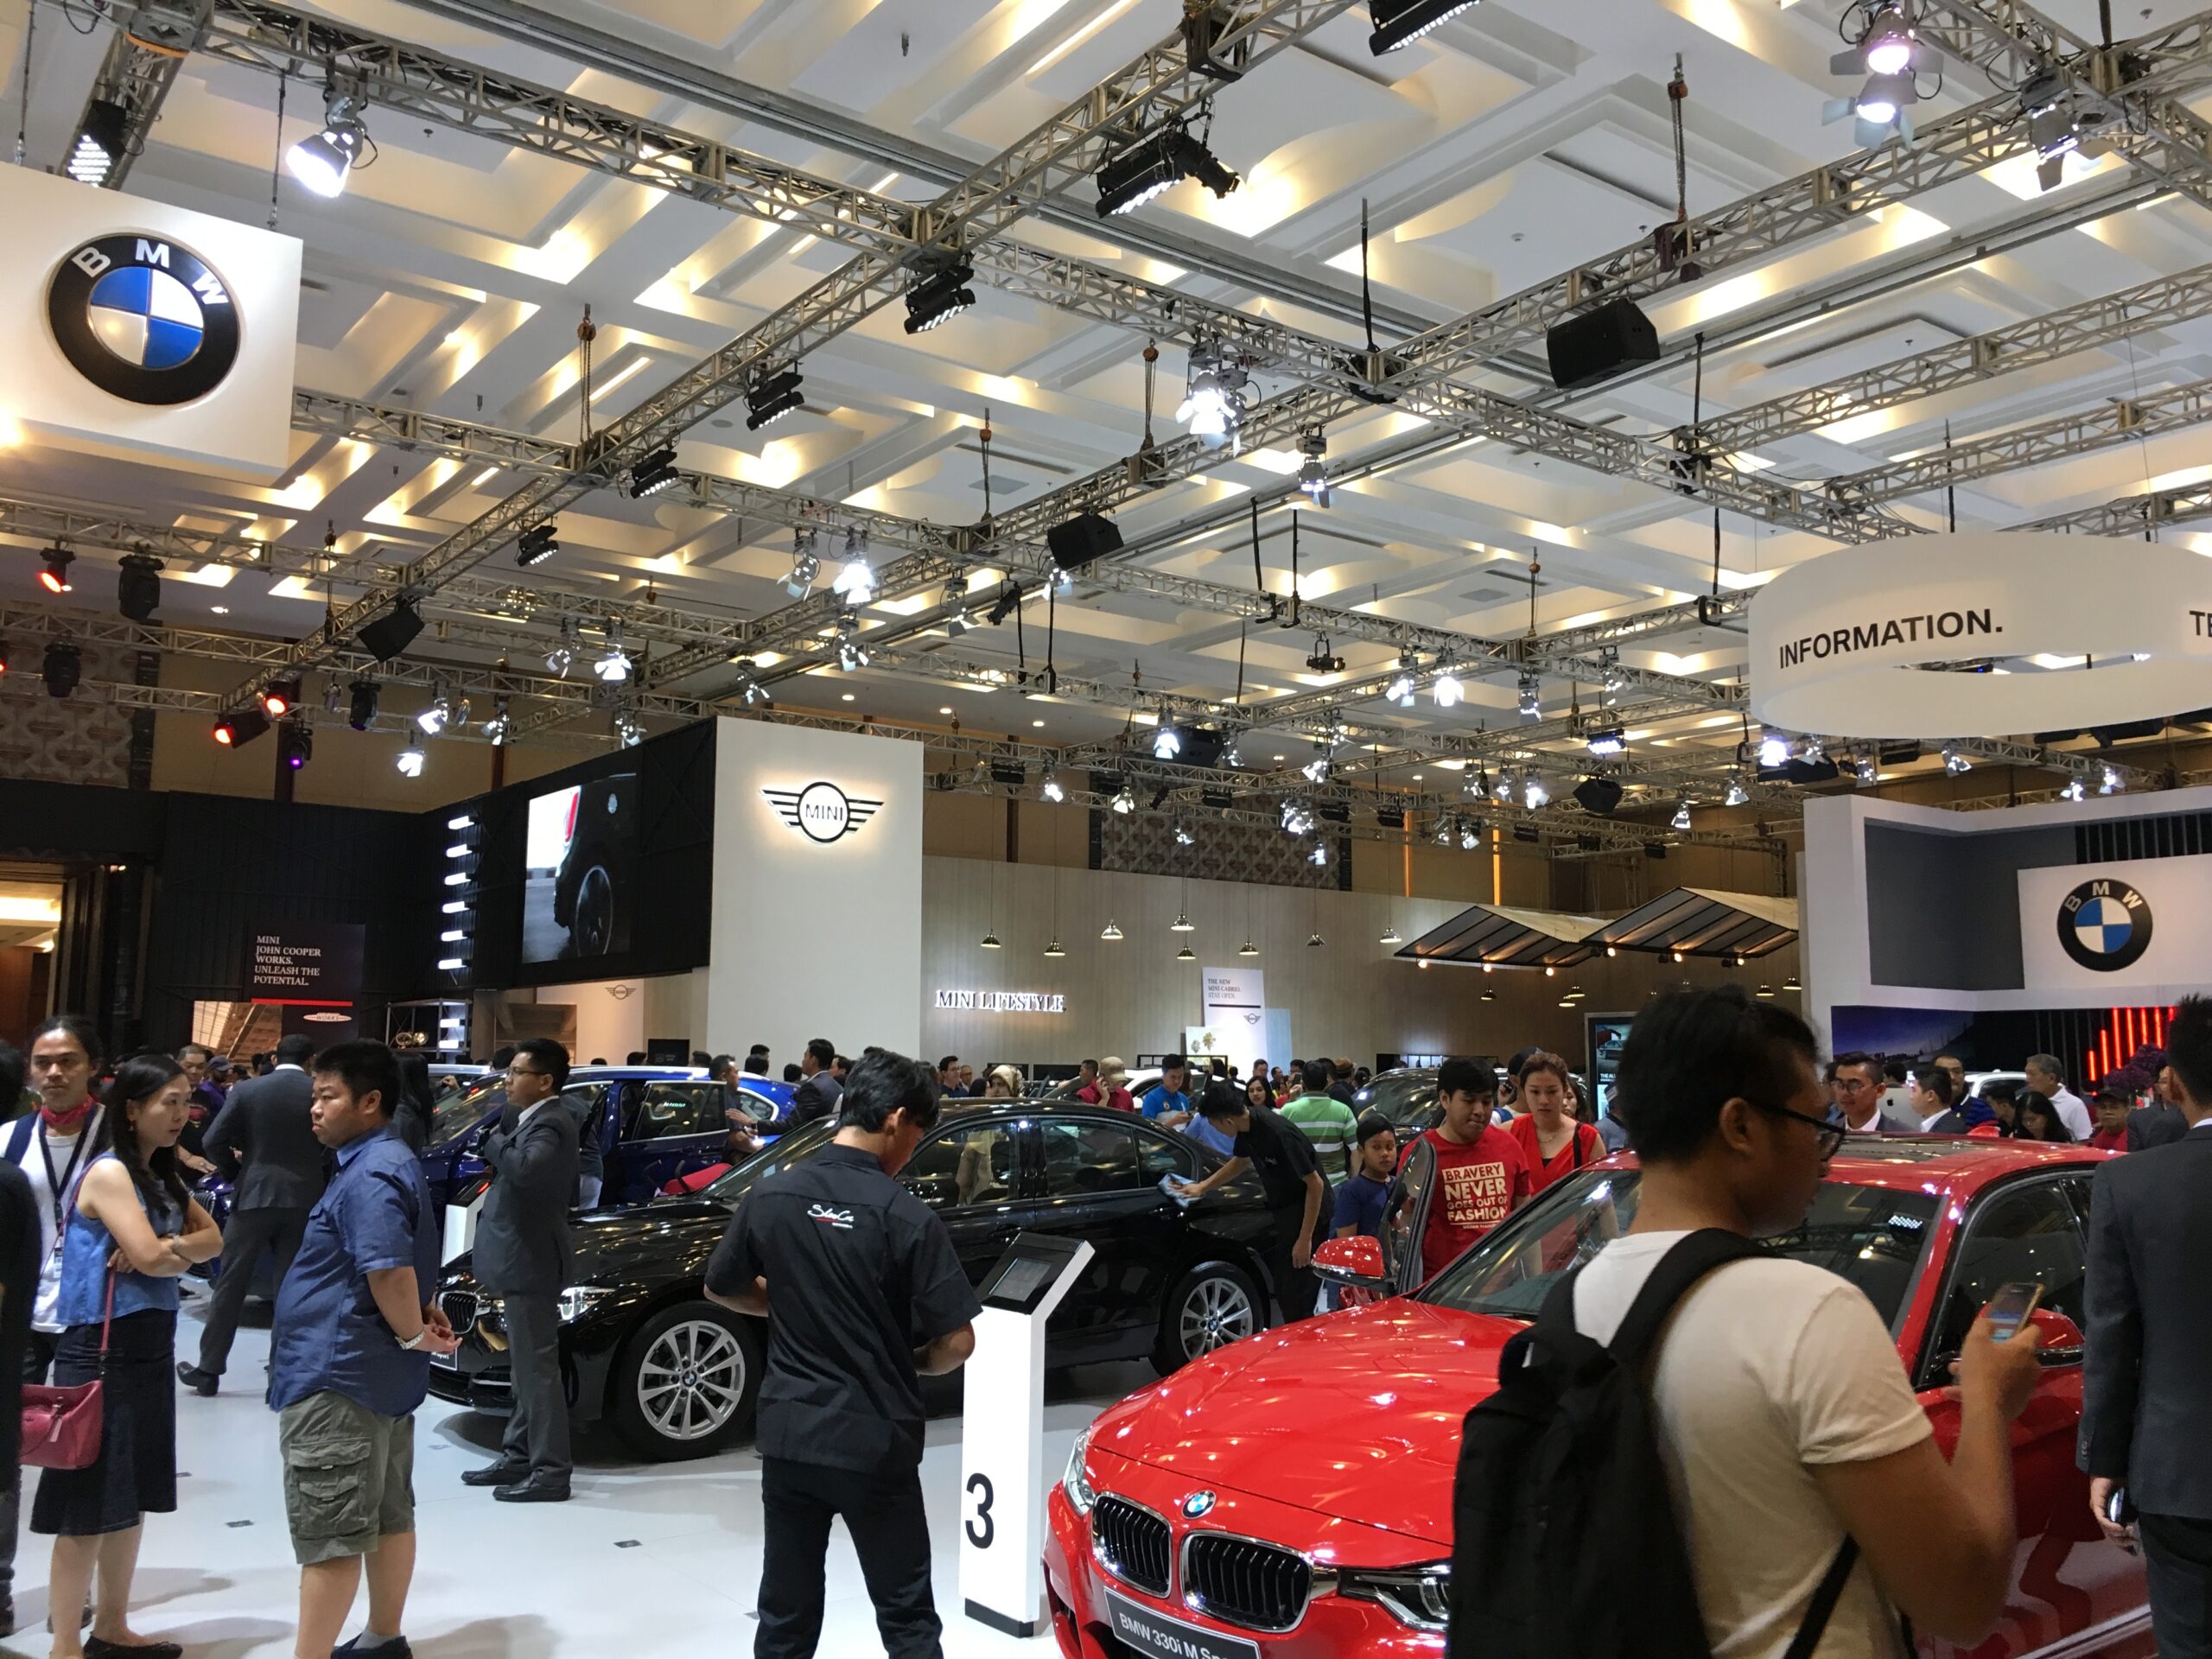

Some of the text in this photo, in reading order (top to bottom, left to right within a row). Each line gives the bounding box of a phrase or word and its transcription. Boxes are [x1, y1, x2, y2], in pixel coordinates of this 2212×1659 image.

[71, 238, 229, 304] BMW
[1779, 608, 2003, 669] INFORMATION.
[805, 804, 843, 821] MINI
[2064, 881, 2143, 912] BMW
[257, 935, 280, 944] MINI
[256, 945, 321, 957] JOHN COOPER
[256, 955, 294, 964] WORKS.
[254, 965, 321, 976] UNLEASH THE
[253, 976, 309, 986] POTENTIAL.
[935, 989, 1067, 1013] MINI LIFESTYLE.
[1446, 1164, 1501, 1181] BRAVERY
[1444, 1177, 1508, 1201] NEVER
[1446, 1195, 1508, 1210] GOES OUT OF
[1447, 1206, 1508, 1222] FASHION
[965, 1472, 995, 1549] 3
[1119, 1613, 1151, 1642] BMW
[1152, 1630, 1183, 1656] 330i
[1183, 1642, 1199, 1659] M
